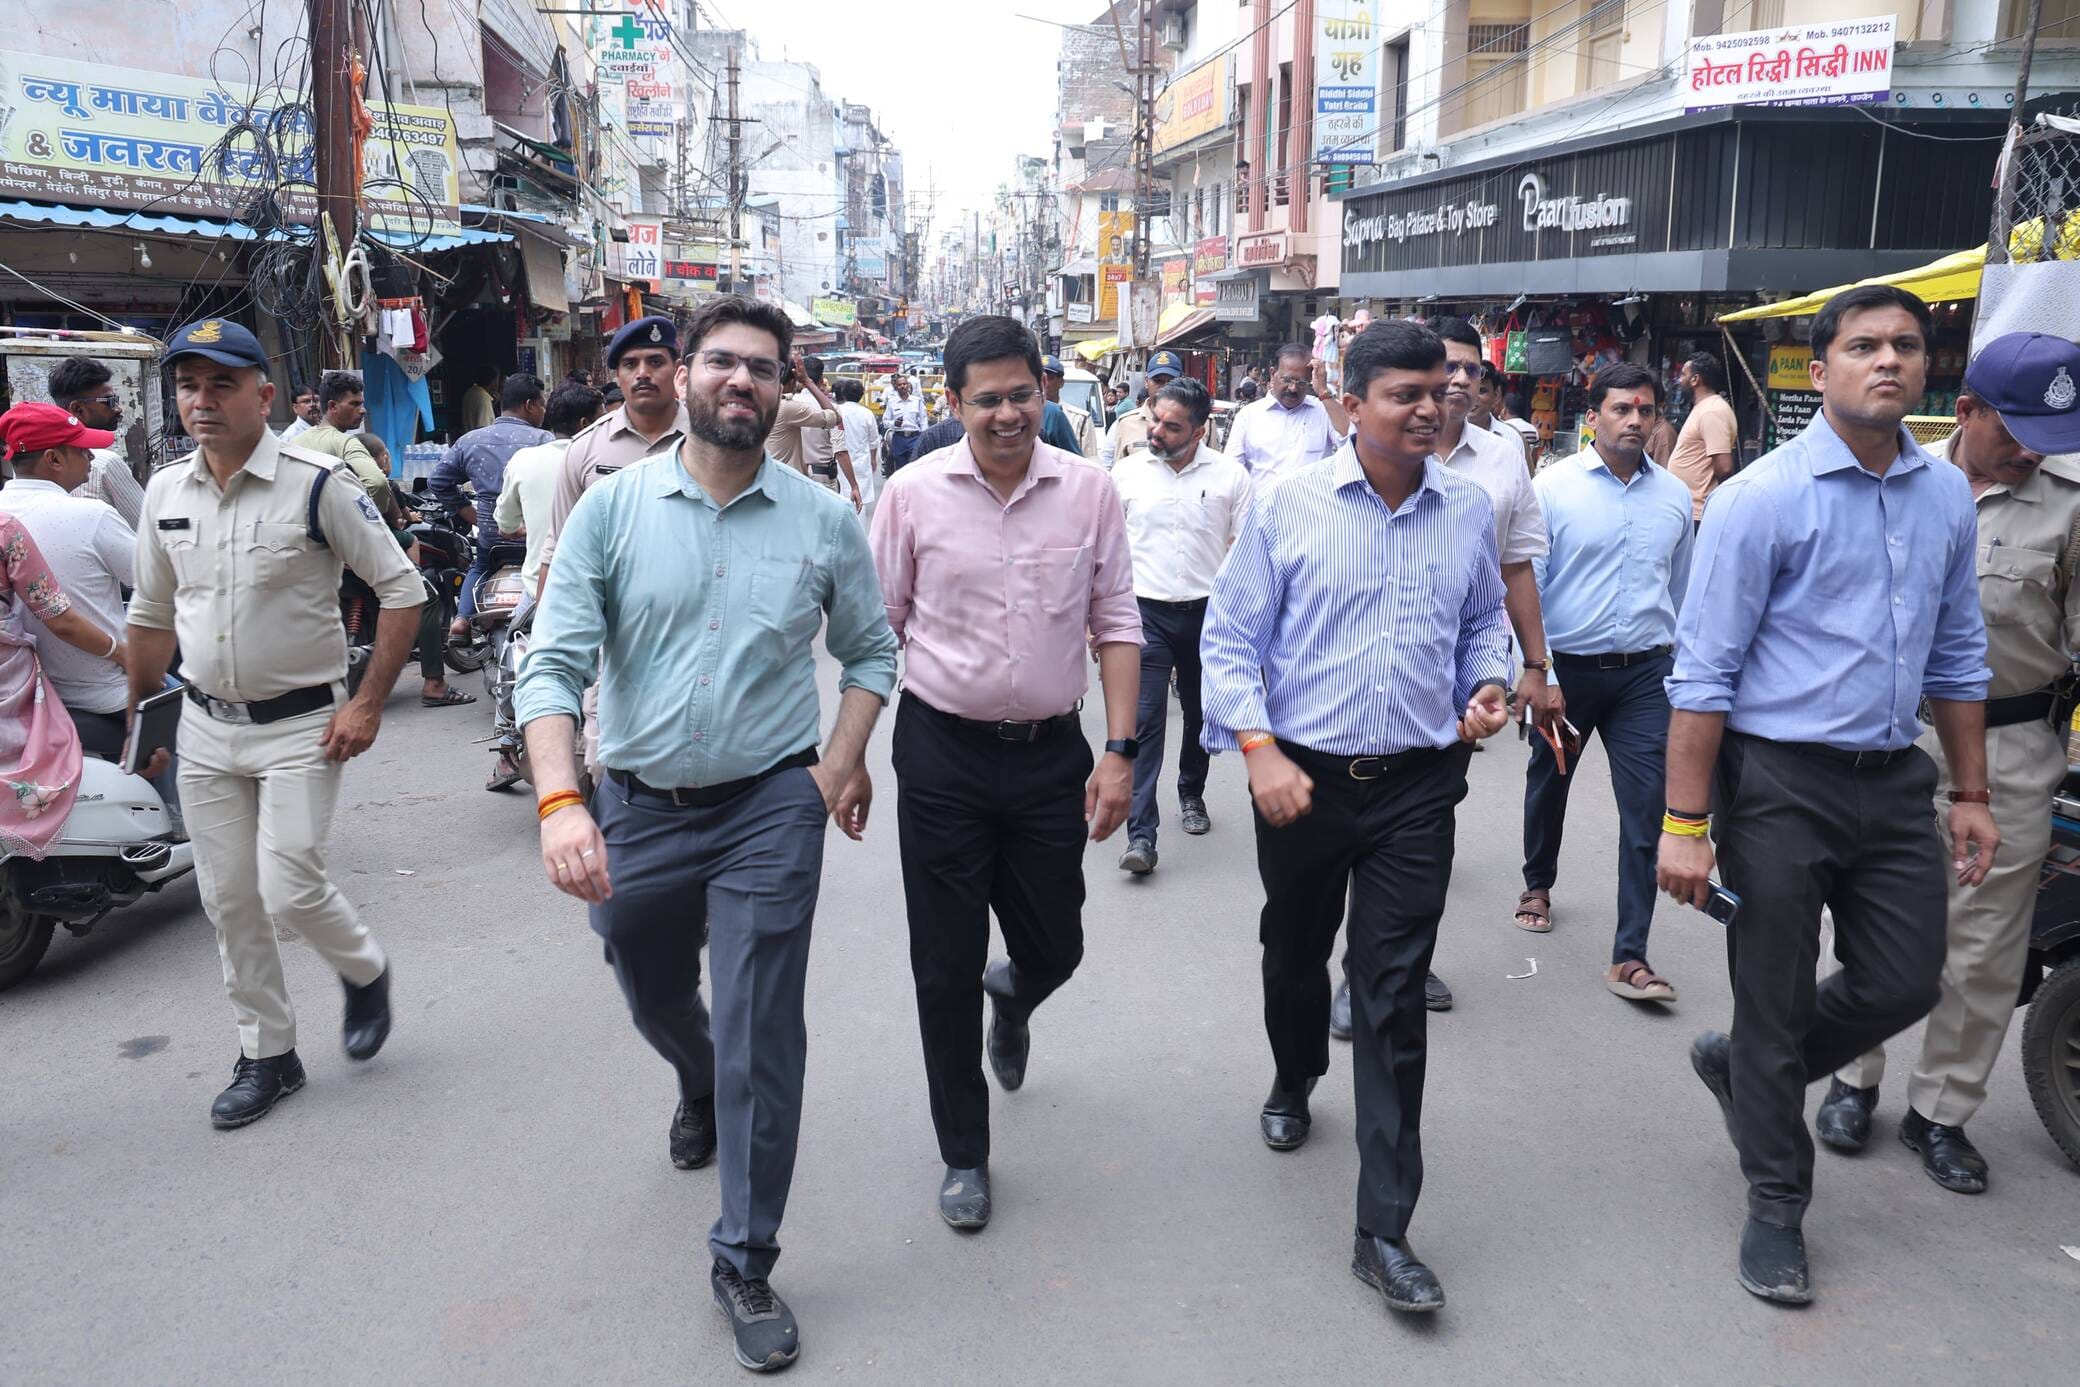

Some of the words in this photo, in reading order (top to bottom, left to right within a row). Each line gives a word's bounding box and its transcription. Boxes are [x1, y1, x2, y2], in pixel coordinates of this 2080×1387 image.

[1324, 10, 1370, 40] यात्री
[1806, 28, 1828, 40] Mob.
[1831, 22, 1890, 37] 9407132212
[1693, 42, 1712, 53] Mob.
[1716, 35, 1770, 50] 9425092598
[601, 50, 656, 62] PHARMACY
[1331, 51, 1363, 81] गृह
[1692, 57, 1743, 91] होटल
[1853, 48, 1888, 73] INN
[20, 75, 93, 121] न्यू
[88, 85, 190, 122] माया
[367, 127, 447, 146] 340763497
[27, 131, 53, 158] &
[59, 128, 205, 175] जनरल
[180, 193, 191, 205] के
[1343, 208, 1384, 260] Sapna
[1387, 214, 1405, 244] Bag
[1406, 210, 1435, 237] Palace
[1436, 206, 1444, 233] &
[1446, 203, 1465, 237] Toy
[1465, 200, 1495, 230] Store
[1780, 356, 1803, 371] PAAN
[1794, 404, 1812, 414] Paan
